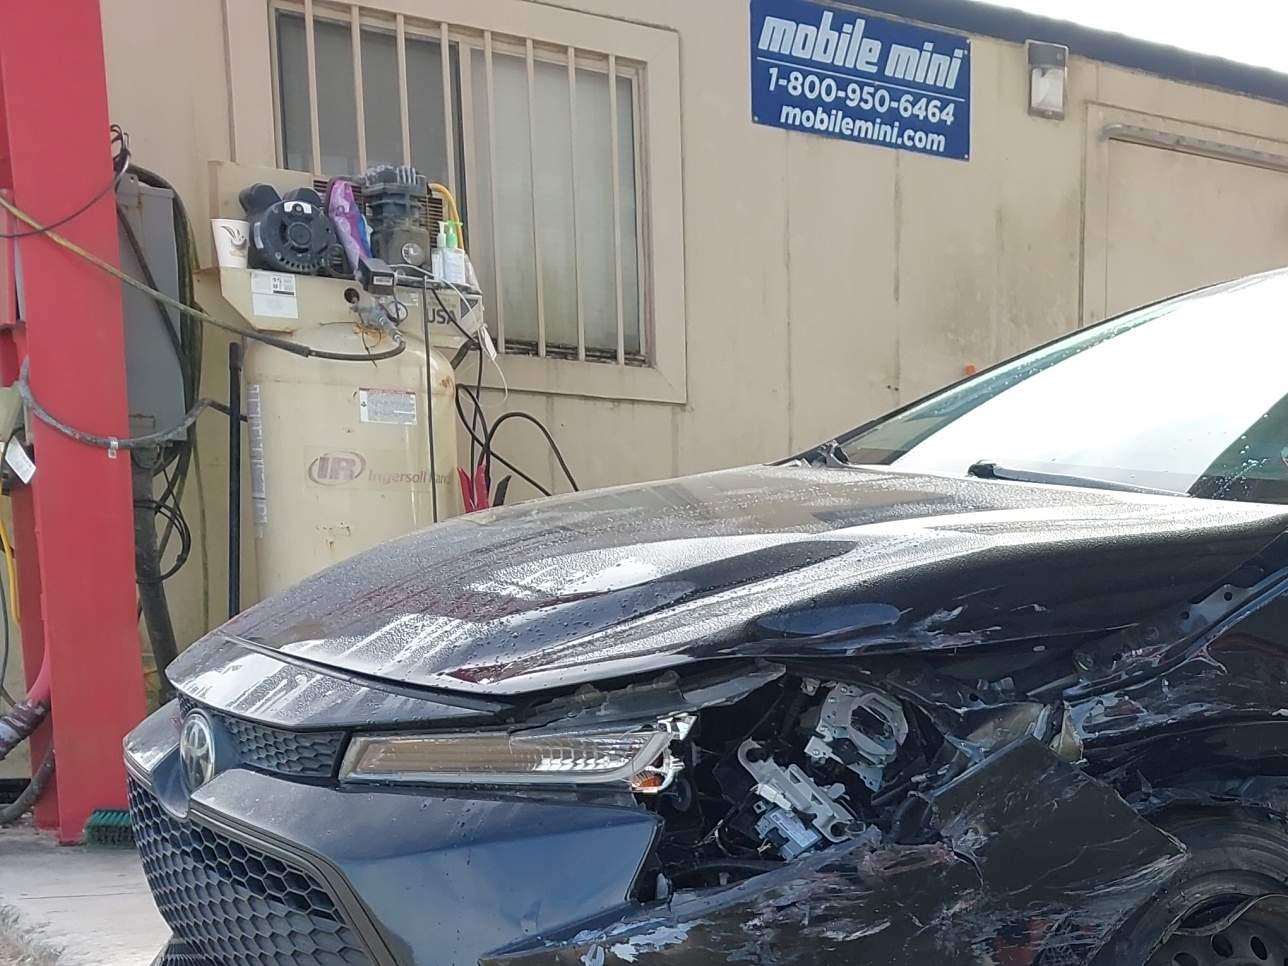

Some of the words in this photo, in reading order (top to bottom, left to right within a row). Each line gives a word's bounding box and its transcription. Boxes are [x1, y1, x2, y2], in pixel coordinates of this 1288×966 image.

[757, 10, 881, 73] mobile
[884, 41, 964, 89] mini
[768, 67, 954, 126] 1-800-950-6464
[780, 104, 945, 152] mobilemini.com
